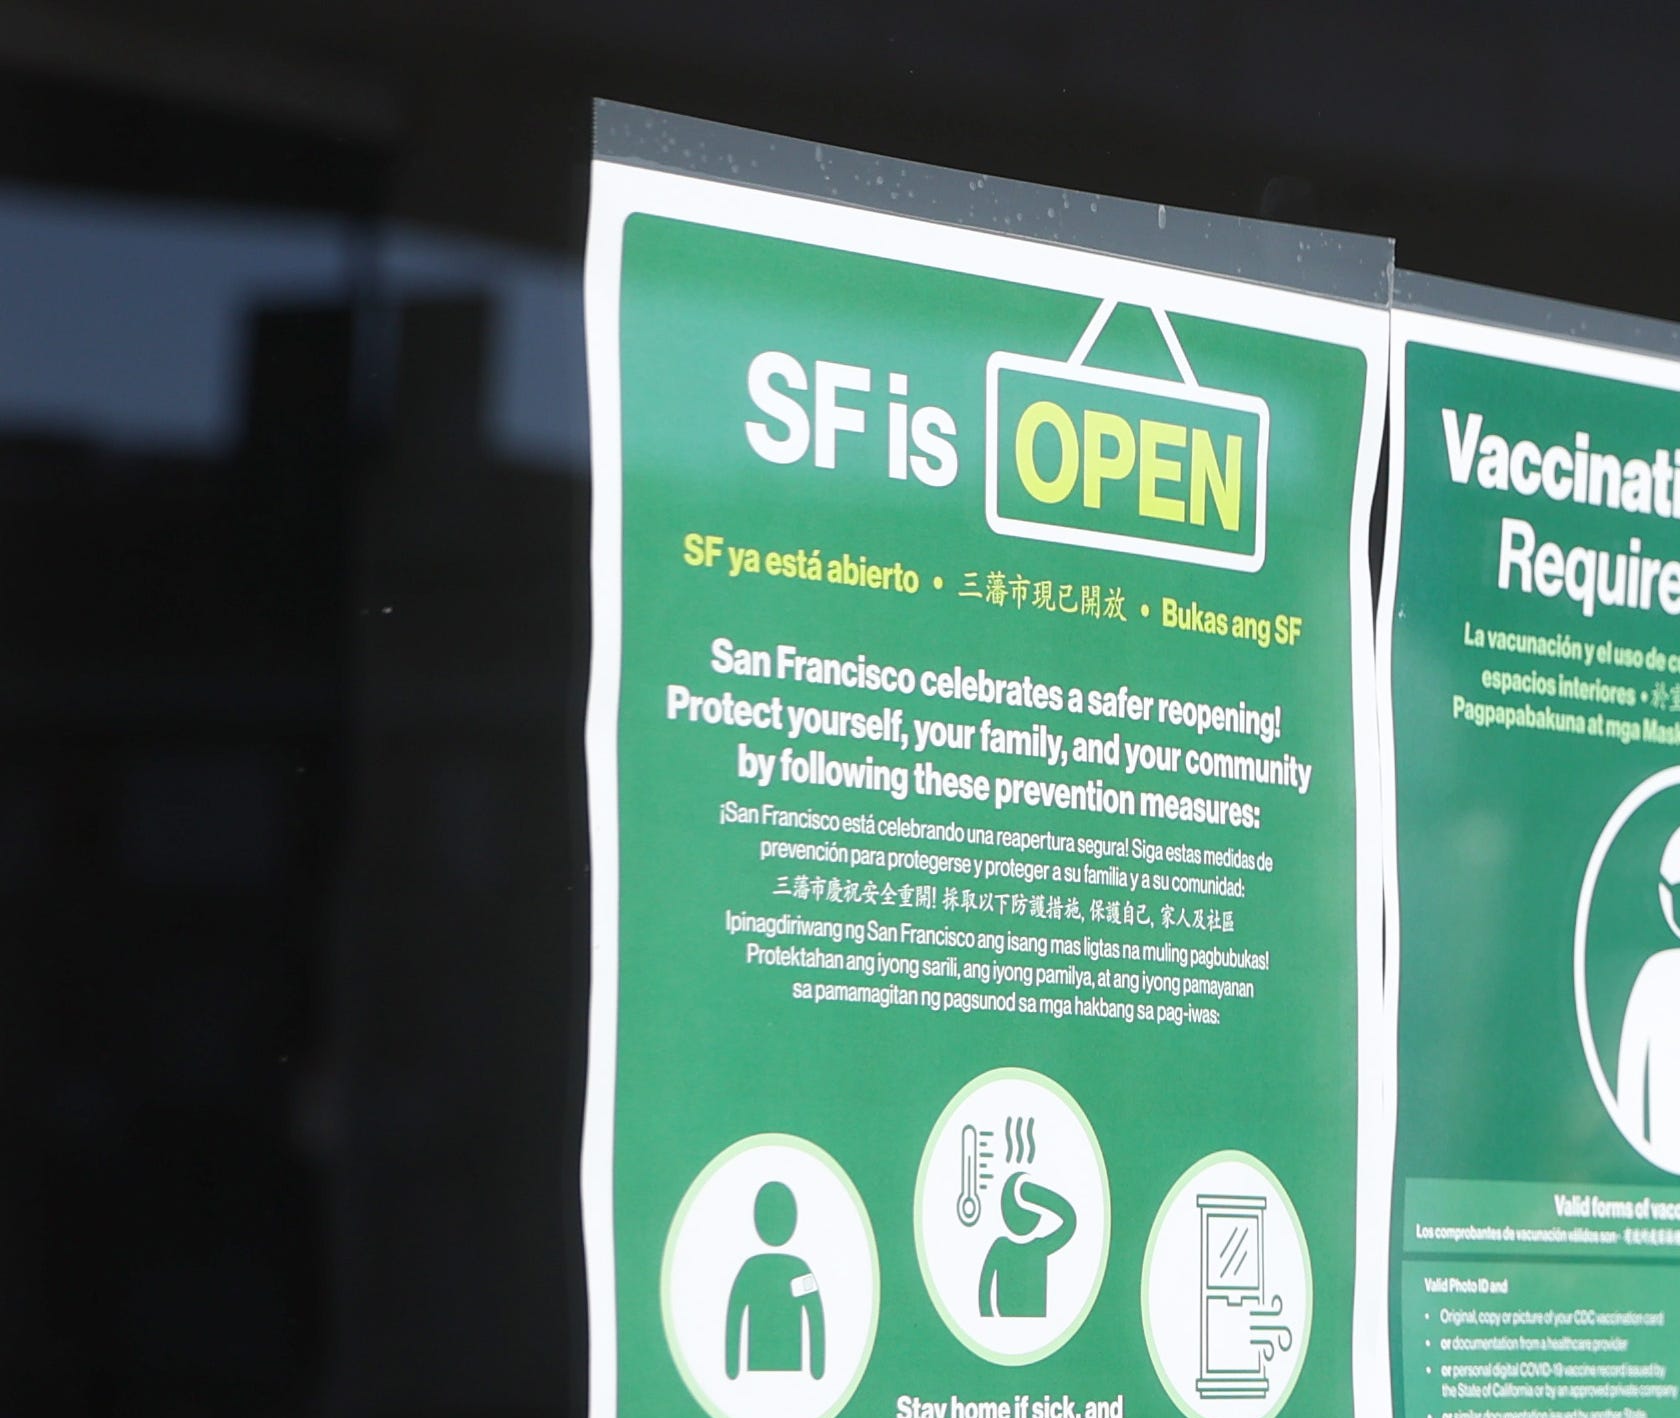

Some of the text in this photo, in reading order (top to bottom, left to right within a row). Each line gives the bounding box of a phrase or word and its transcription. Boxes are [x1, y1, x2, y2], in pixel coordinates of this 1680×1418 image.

[744, 350, 1243, 532] SF is OPEN
[683, 532, 919, 593] SF ya está abierto
[958, 570, 1127, 622] 三藩市現已開放
[1162, 597, 1302, 648] Bukas ang SF
[710, 637, 1281, 744] San Francisco celebrates a safer reopening!
[1481, 669, 1636, 706] espacios interiores
[667, 684, 1312, 794] Protect yourself, your family, and your community
[738, 742, 1260, 829] by following these prevention measures:
[1424, 1277, 1508, 1294] Valid Photo ID and
